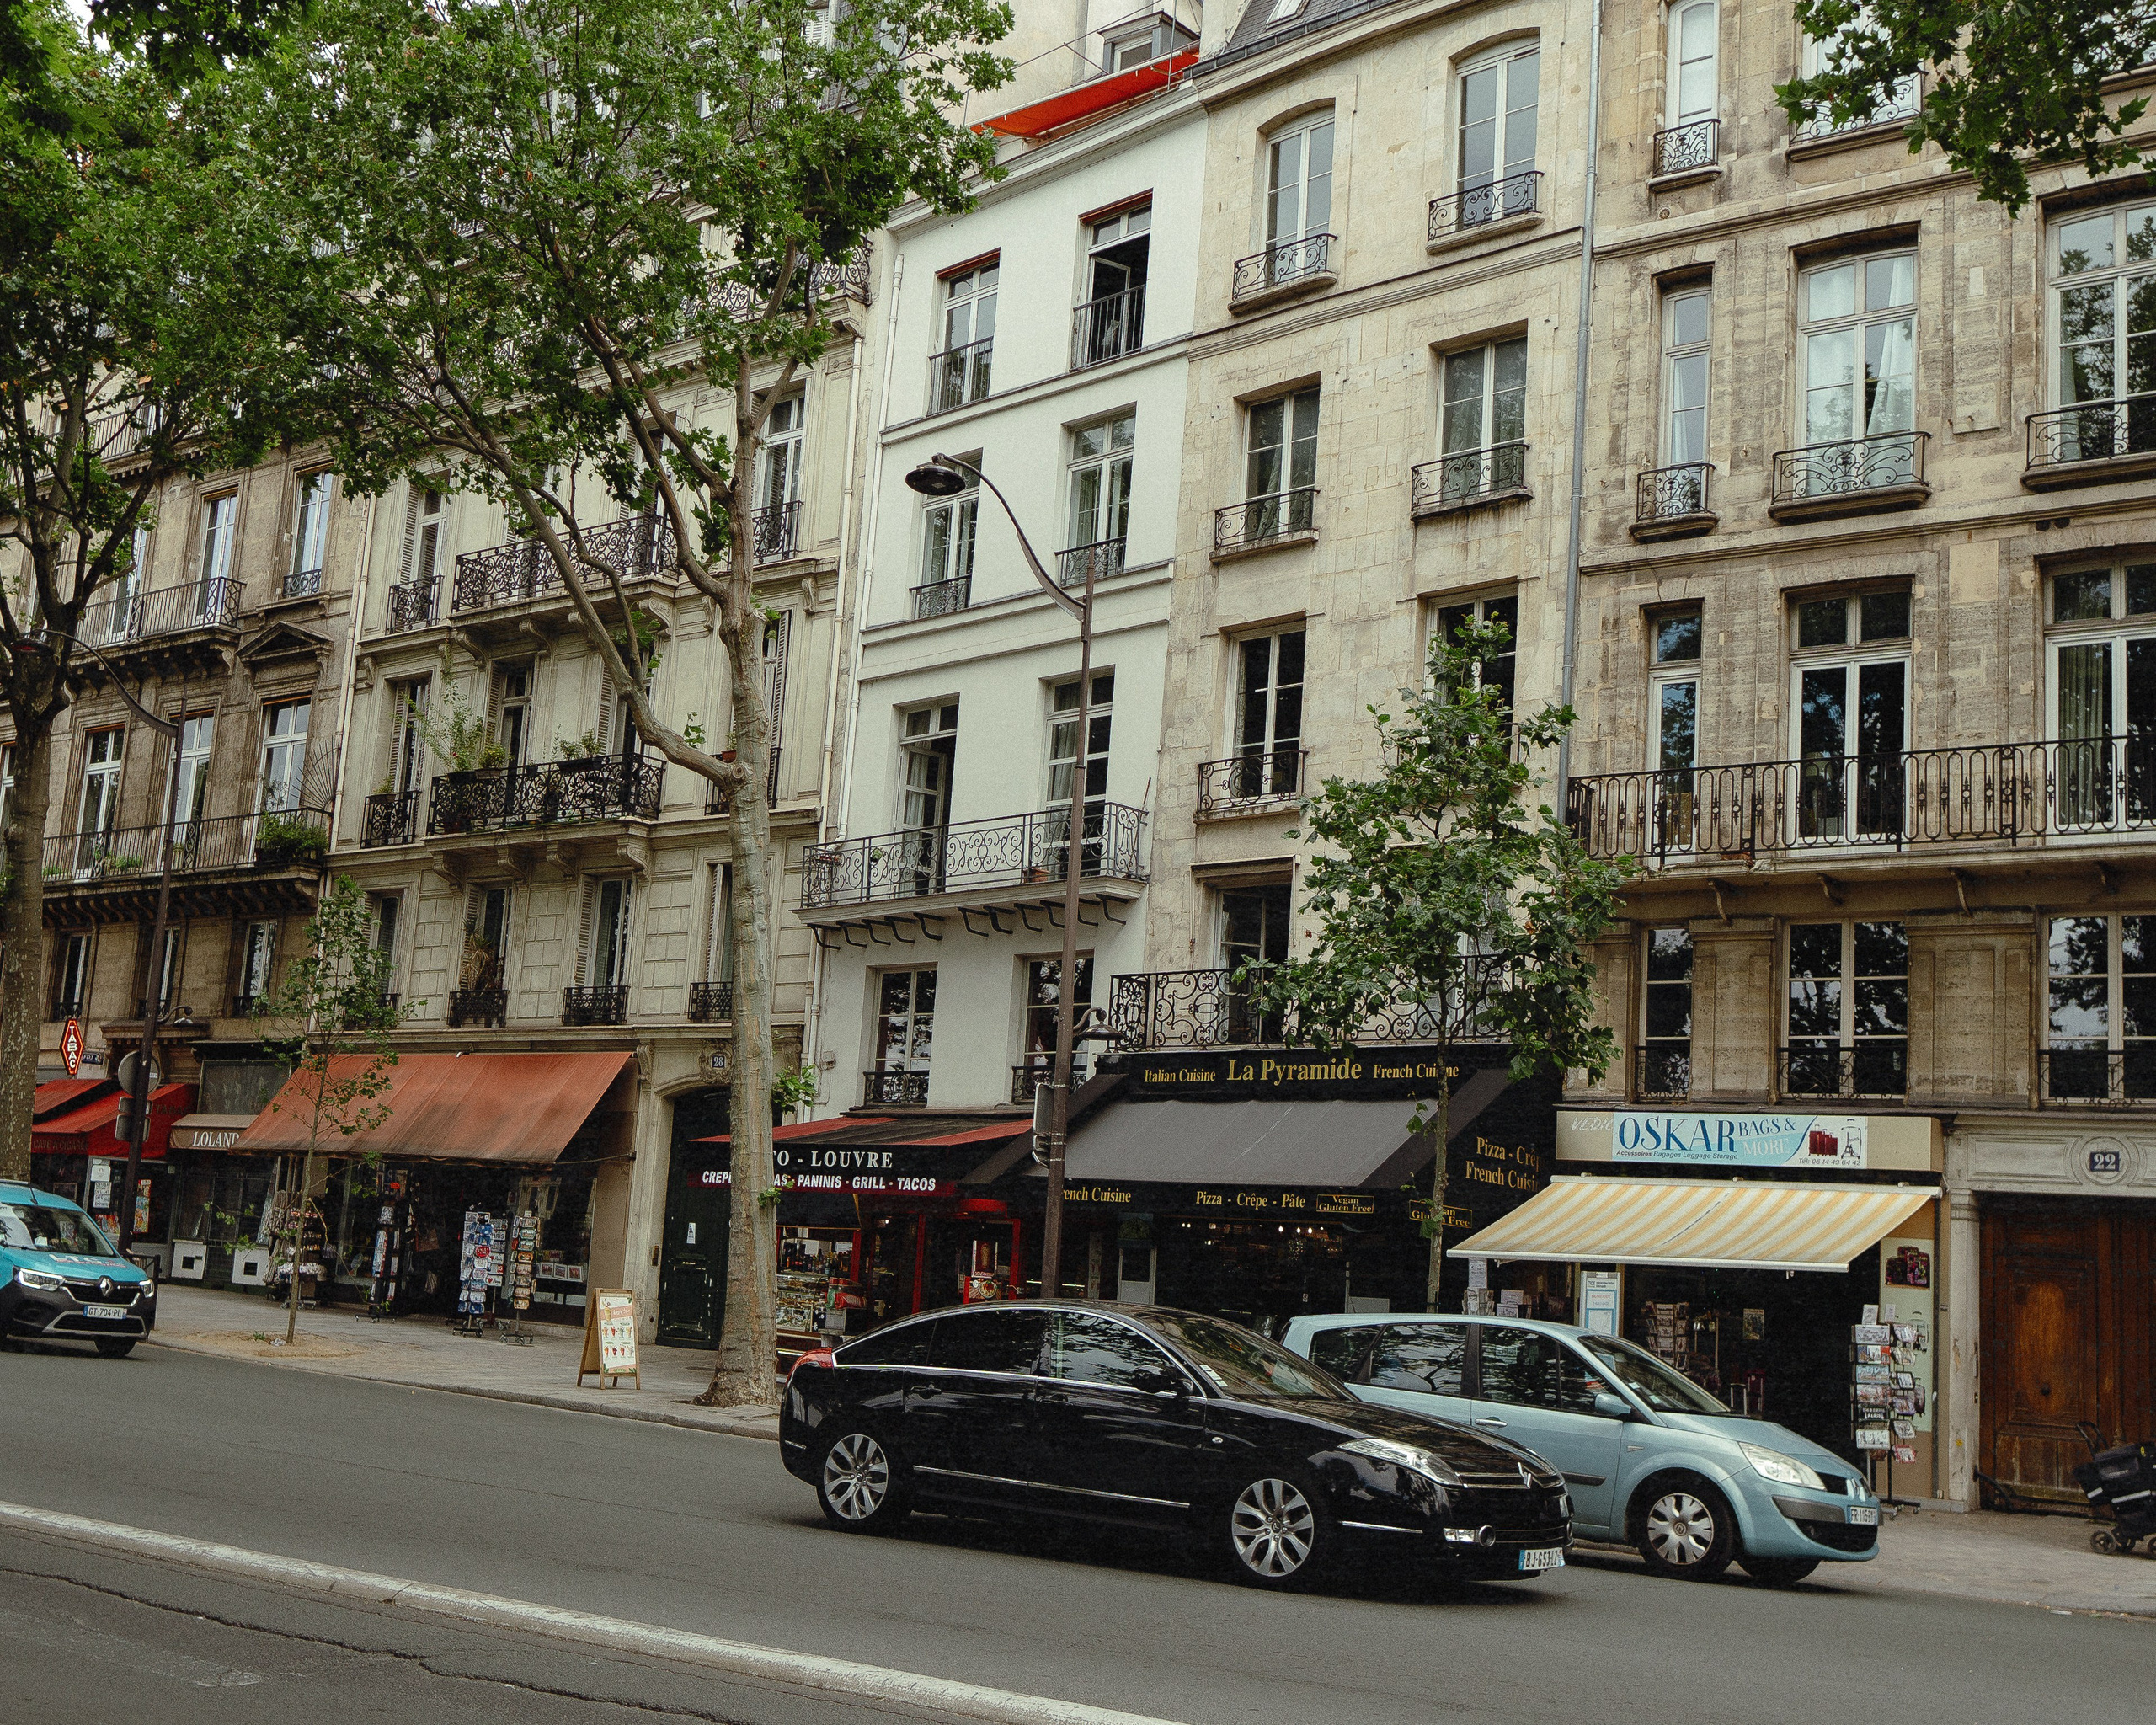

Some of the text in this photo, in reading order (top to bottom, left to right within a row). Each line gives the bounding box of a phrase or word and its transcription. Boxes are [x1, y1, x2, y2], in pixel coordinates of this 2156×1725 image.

[67, 1025, 78, 1068] TABAC
[713, 1056, 723, 1067] 28
[1144, 1067, 1216, 1082] Italian Cuisine
[1226, 1057, 1362, 1086] La Pyramide
[1373, 1062, 1460, 1079] French Cuine
[1618, 1115, 1738, 1153] OSKAR
[1738, 1117, 1796, 1137] BAGS &
[1476, 1136, 1506, 1161] Pizza
[1653, 1151, 1682, 1159] Bagages
[1683, 1151, 1711, 1160] Luggage
[1743, 1138, 1790, 1156] MORE
[810, 1151, 893, 1169] LOUVRE
[2094, 1153, 2116, 1170] 22
[1465, 1160, 1505, 1186] French
[797, 1174, 842, 1188] PANINIS
[852, 1176, 886, 1189] GRILL
[897, 1178, 937, 1191] TACOS
[1091, 1186, 1132, 1203] Cuisine
[1196, 1190, 1222, 1204] Pizza
[1236, 1193, 1267, 1210] Crêpe
[1281, 1193, 1305, 1209] Pâte
[1332, 1195, 1359, 1205] Vegan
[1319, 1202, 1372, 1213] Gluten Free
[1449, 1215, 1470, 1226] Free
